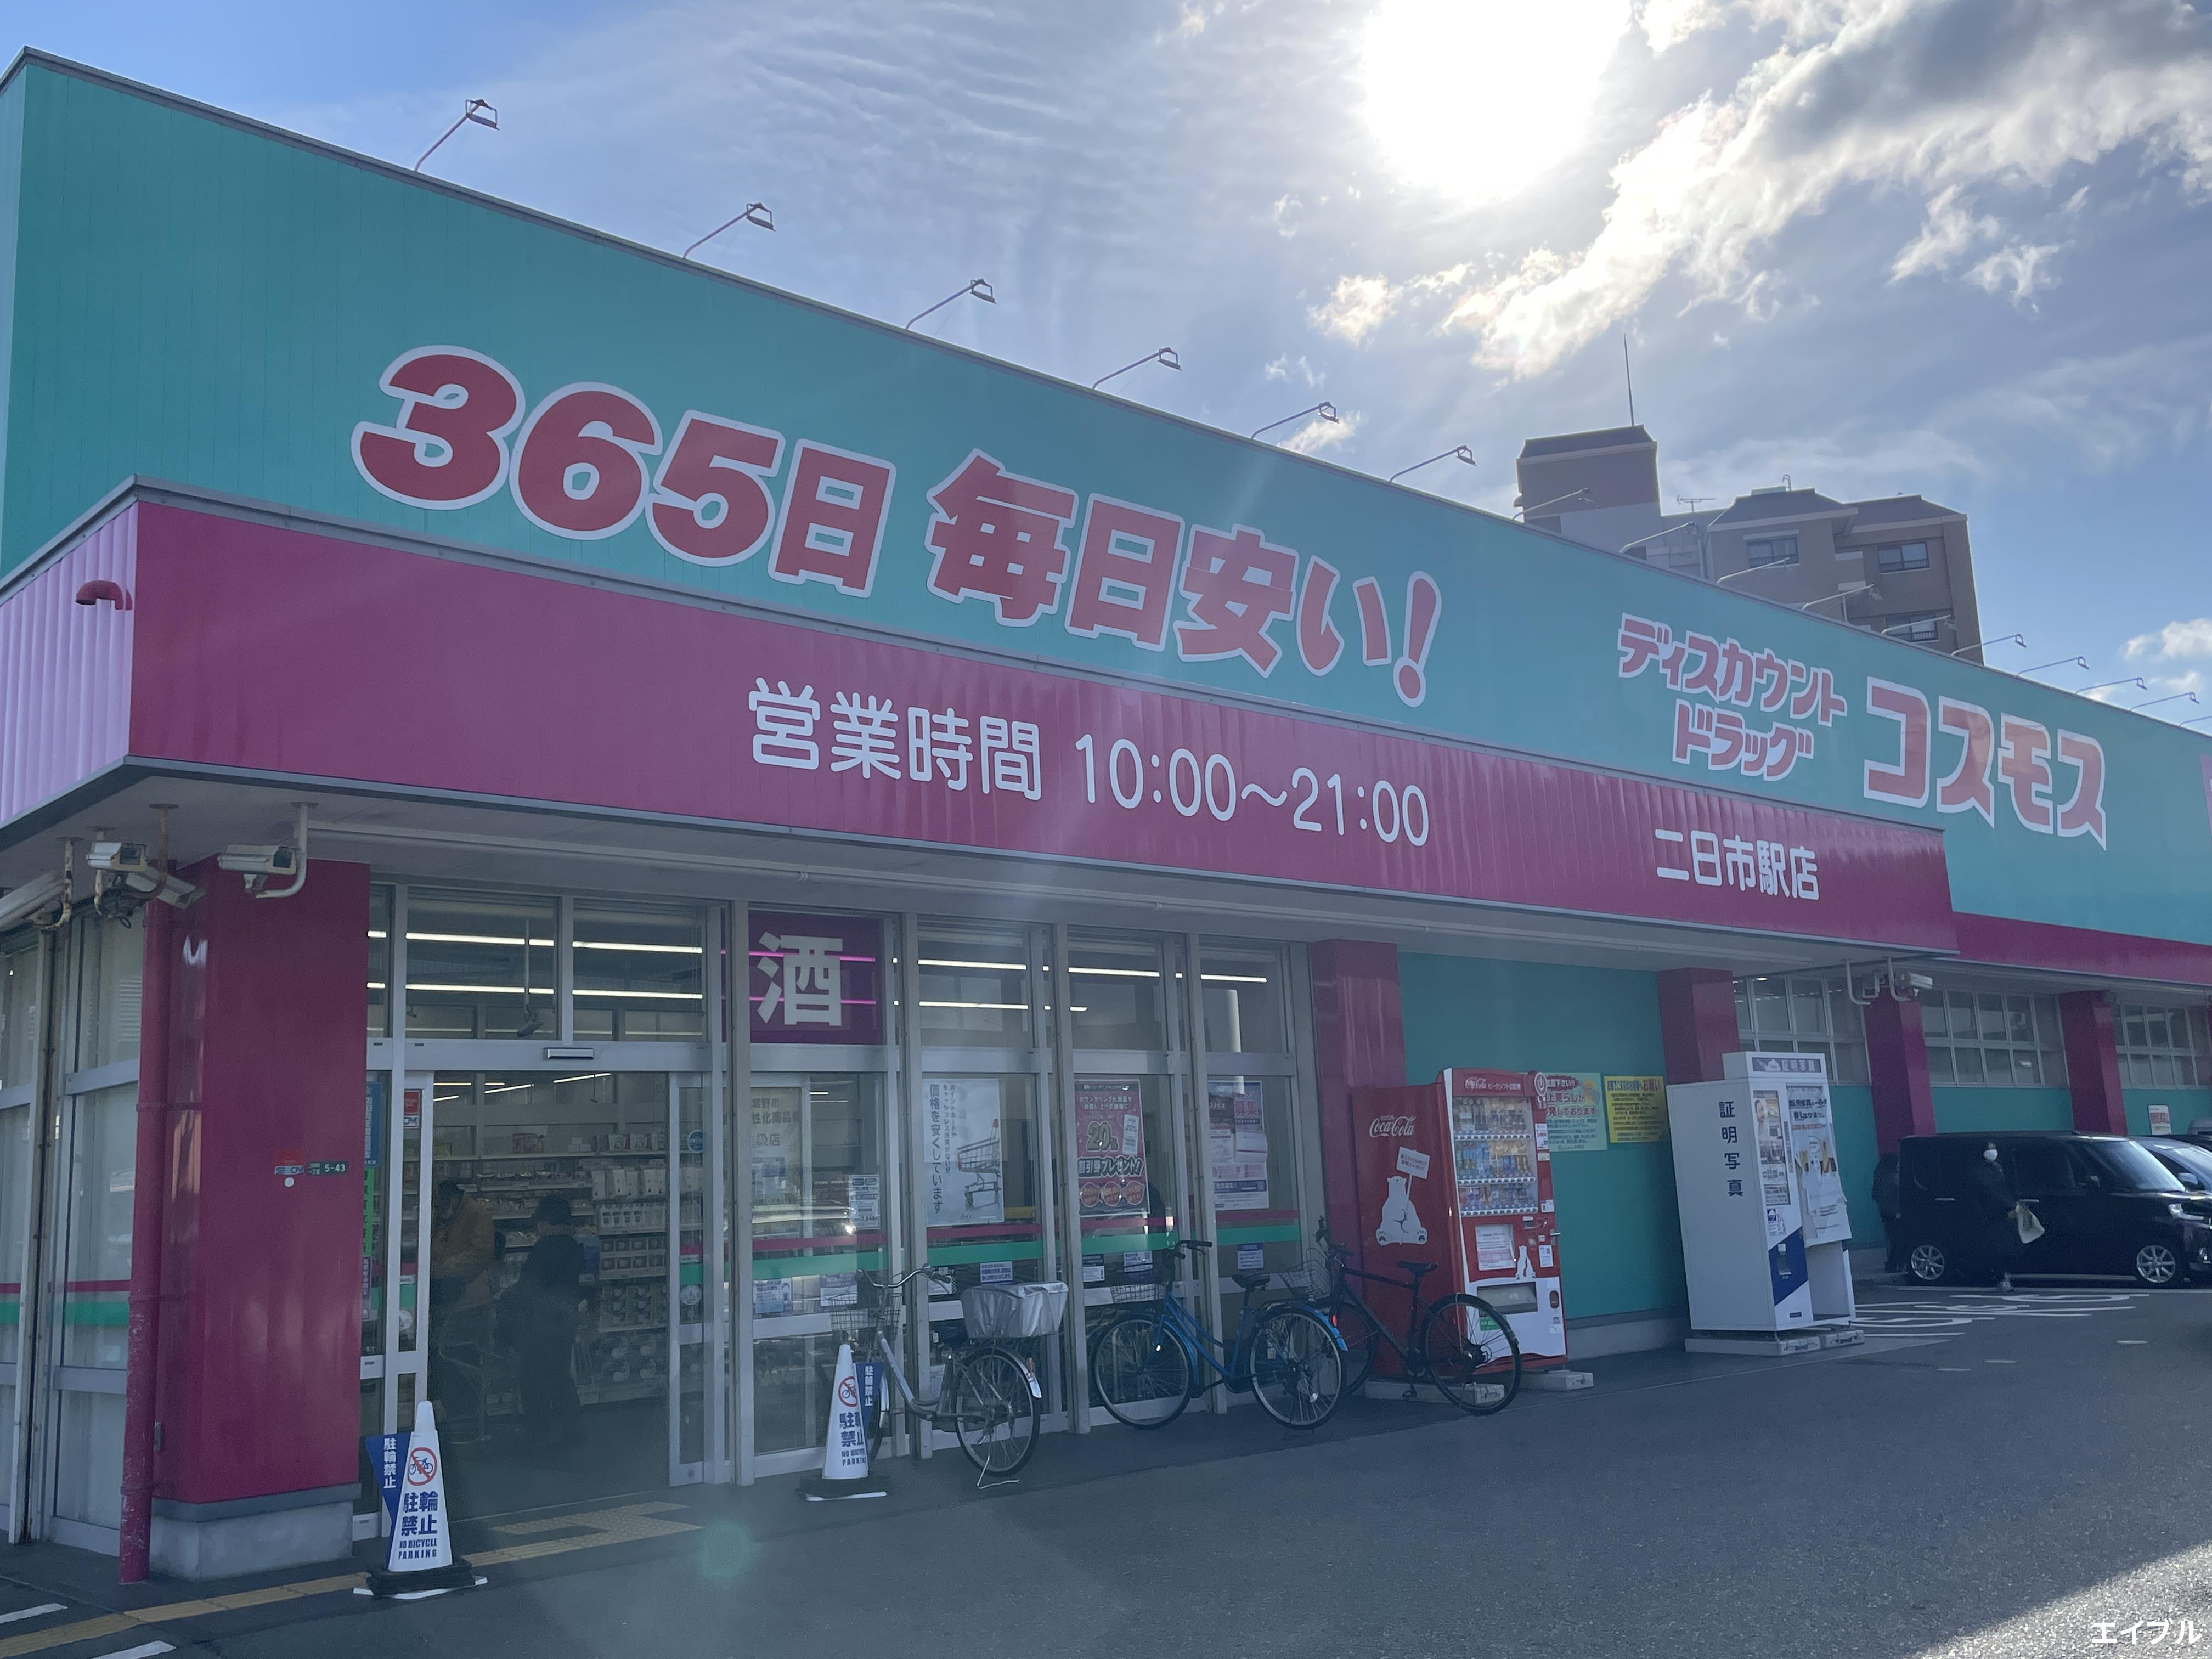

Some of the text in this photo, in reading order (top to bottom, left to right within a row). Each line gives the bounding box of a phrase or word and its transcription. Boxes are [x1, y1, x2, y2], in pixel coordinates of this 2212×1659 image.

[352, 345, 1442, 708] 365日 毎日安い!
[1617, 612, 1847, 725] ディスカウント
[748, 677, 1042, 802] 営業時間
[1672, 699, 1814, 781] ドラッグ
[1863, 676, 2107, 850] コスモス
[1655, 828, 1820, 901] 二日市駅店
[757, 931, 843, 1026] 酒
[1782, 1059, 1816, 1072] 証明写真
[1234, 1100, 1259, 1116] 募集
[1369, 1116, 1417, 1138] Coca-Cola
[324, 1164, 346, 1173] 5-43
[929, 1084, 943, 1214] 価格を安くしています
[1718, 1101, 1744, 1197] 証明写真
[864, 1365, 874, 1407] 駐輪禁止
[383, 1438, 397, 1489] 駐輪禁止
[400, 1514, 438, 1537] 禁止
[403, 1492, 438, 1513] 駐輪
[398, 1549, 437, 1560] PARKING
[399, 1538, 437, 1549] NO BICYCLE
